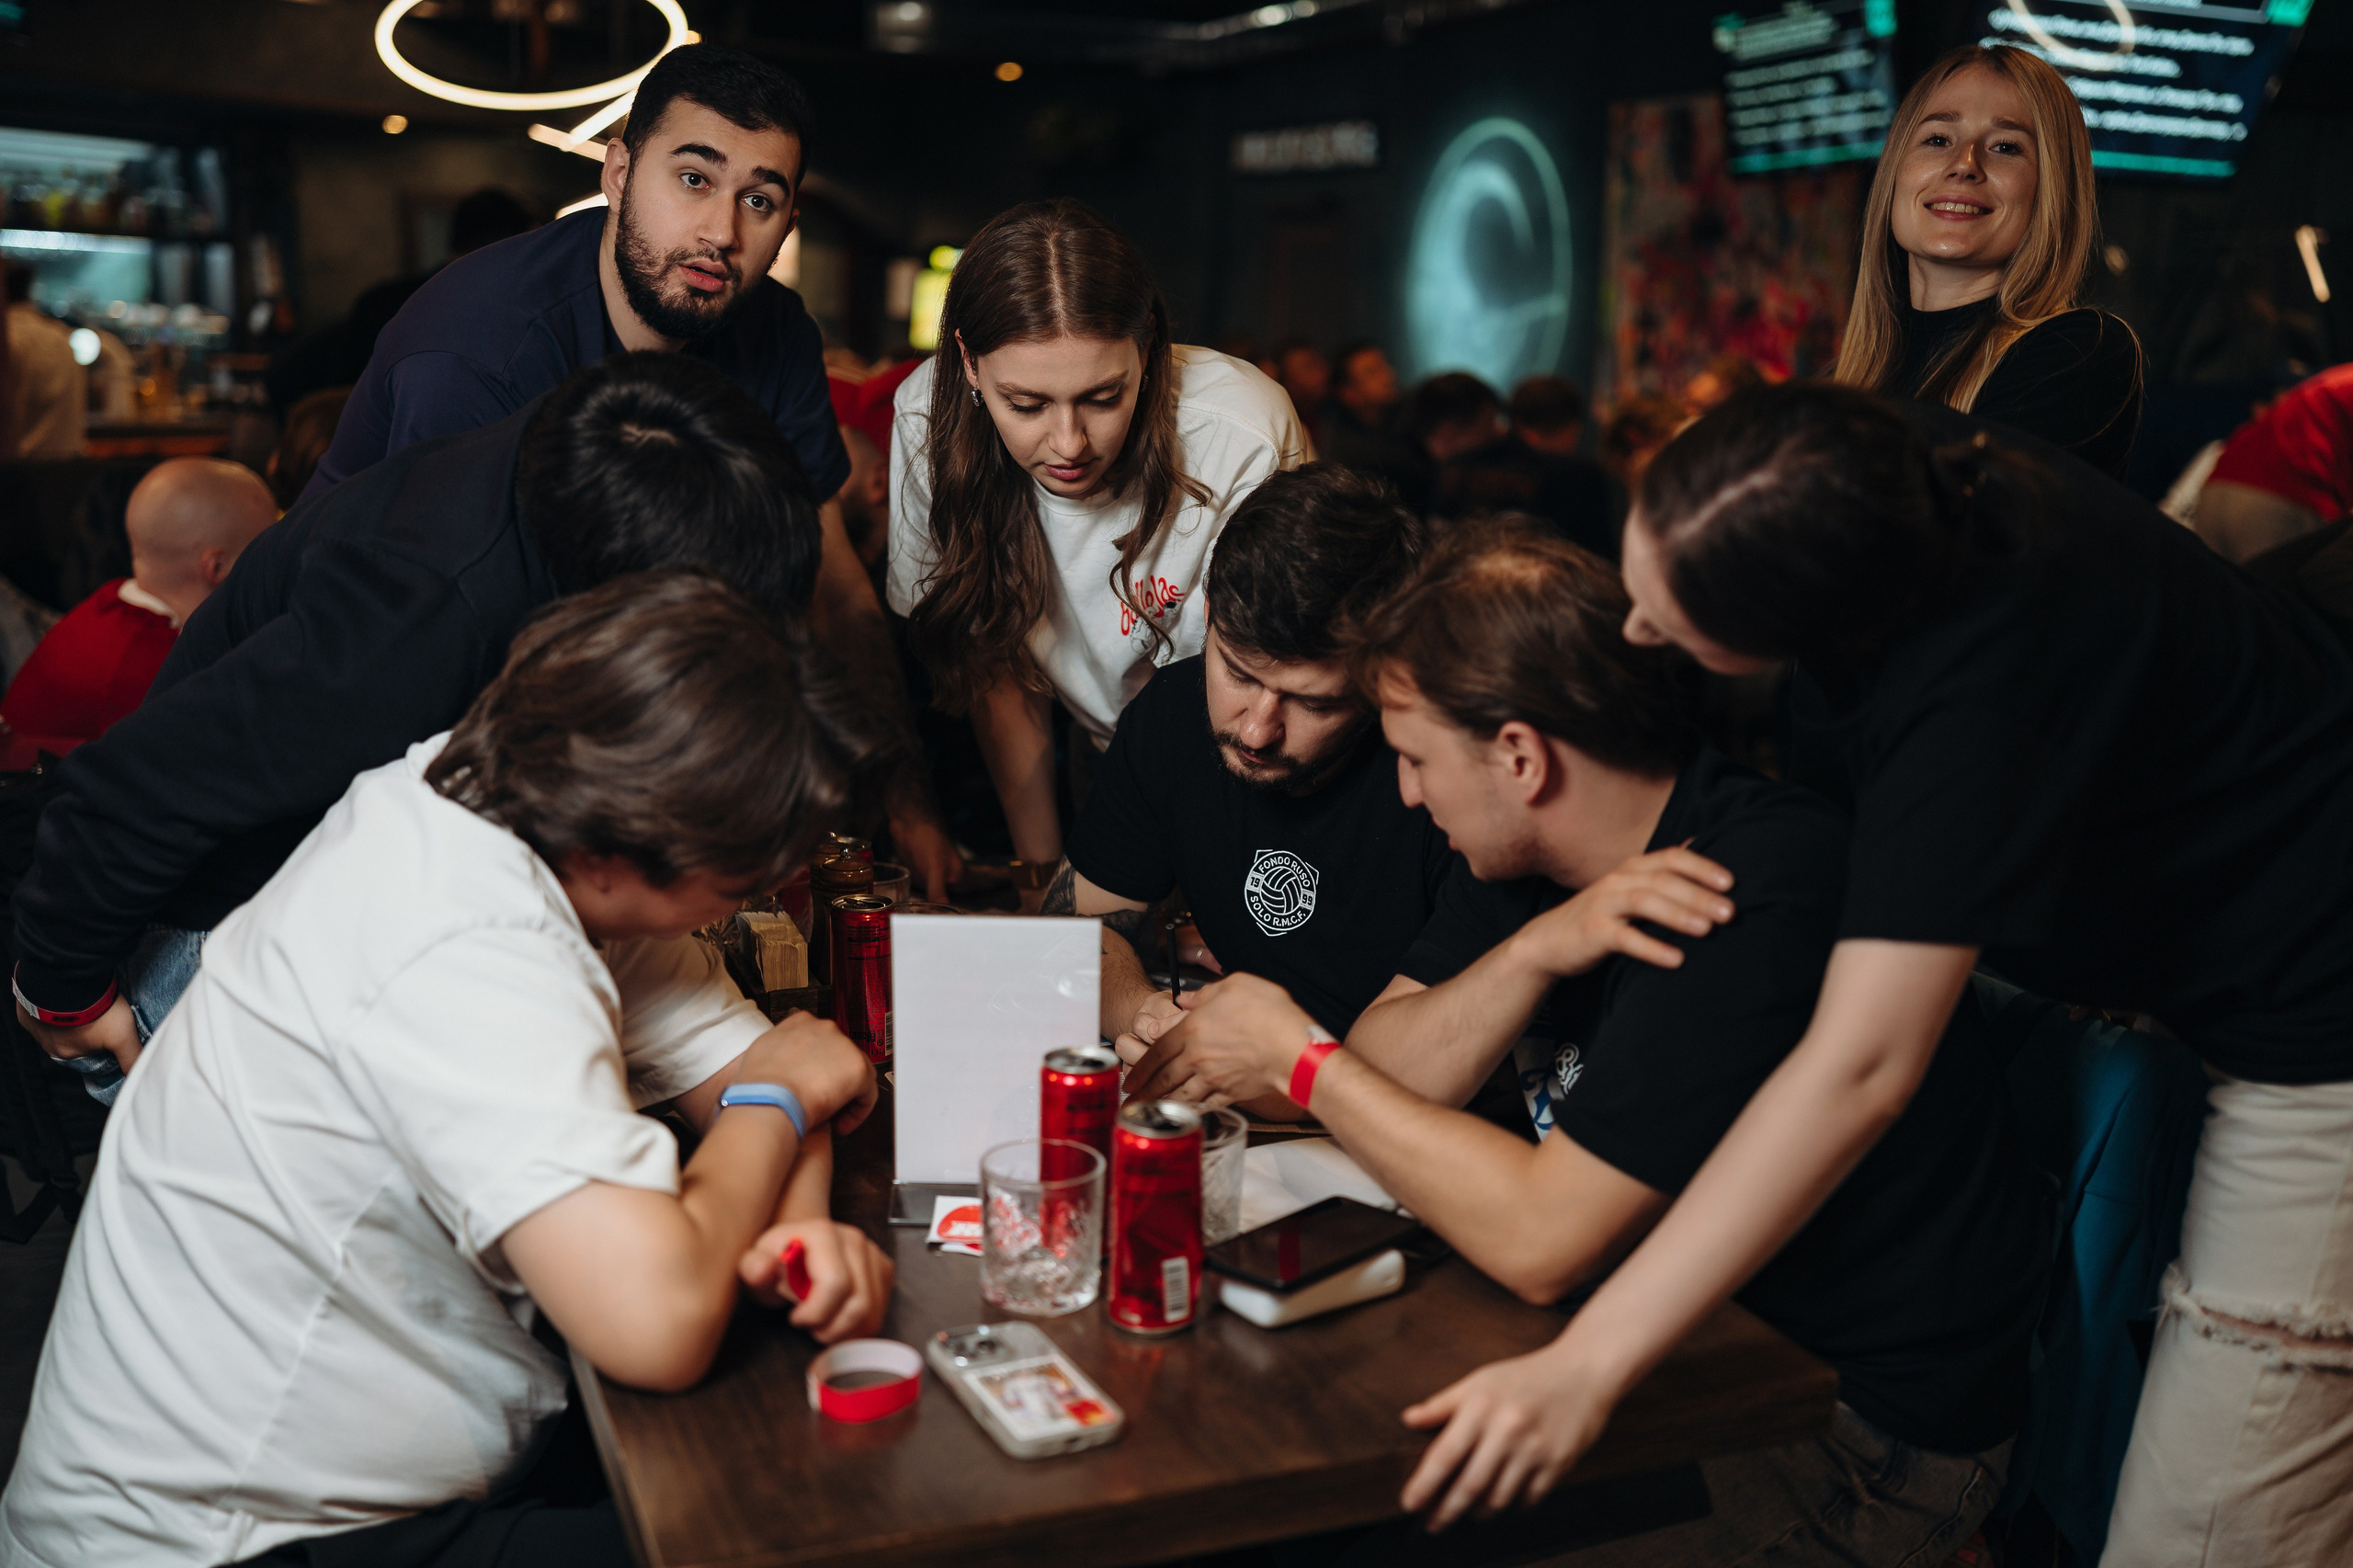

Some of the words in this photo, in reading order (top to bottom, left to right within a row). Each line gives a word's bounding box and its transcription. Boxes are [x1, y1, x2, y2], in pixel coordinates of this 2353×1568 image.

[1257, 856, 1290, 874] FONDO
[1290, 860, 1311, 888] RUSO
[1250, 876, 1261, 889] 19
[1302, 893, 1313, 906] 99
[1250, 895, 1271, 922] SOLO
[1272, 910, 1306, 927] R.M.C.F.
